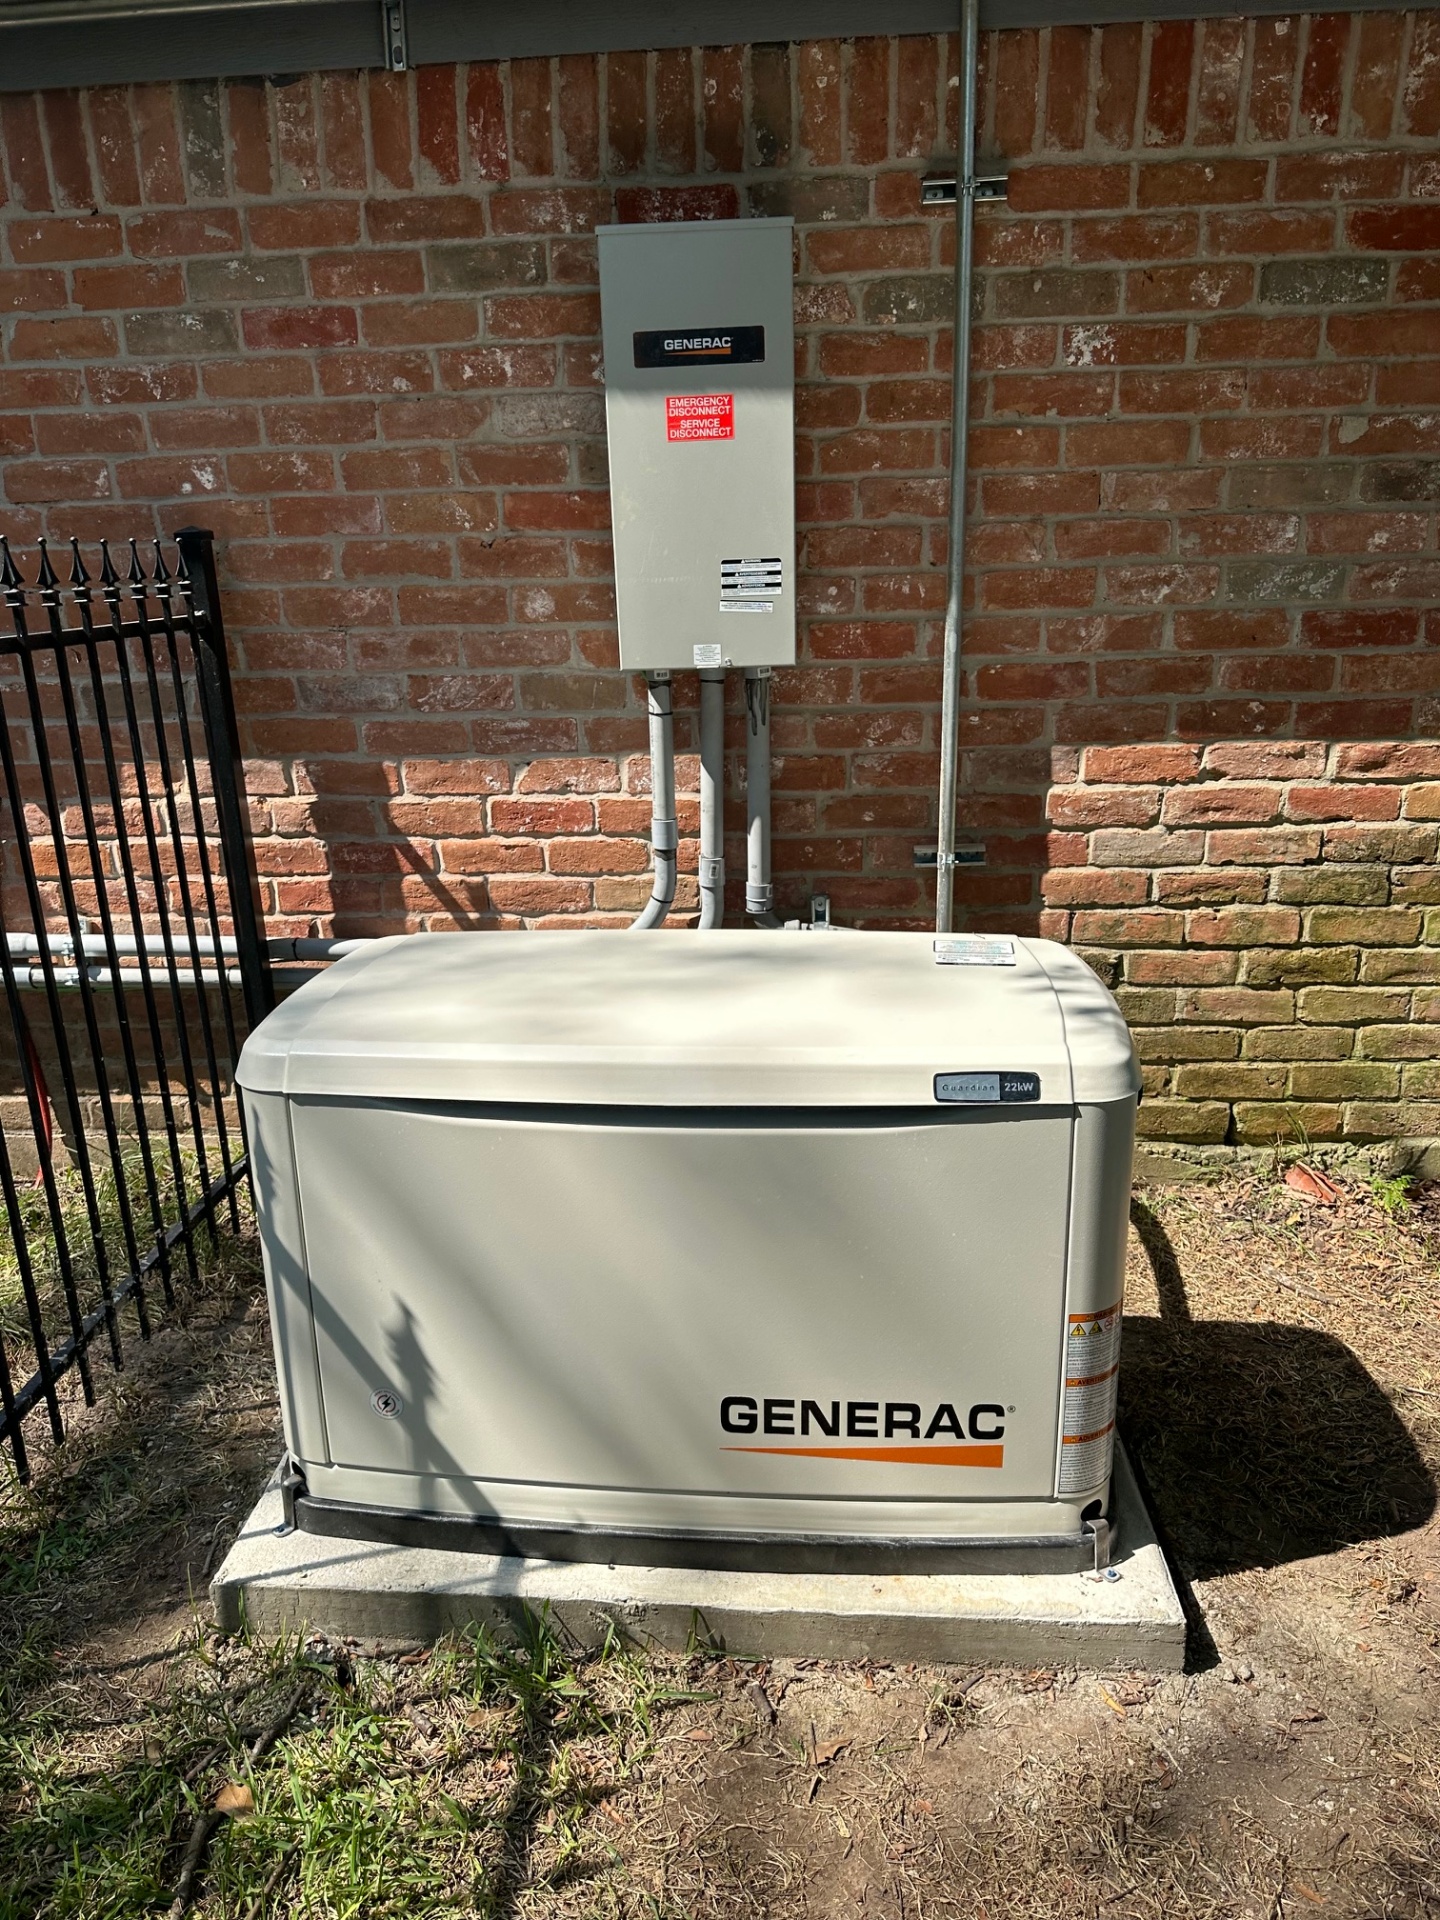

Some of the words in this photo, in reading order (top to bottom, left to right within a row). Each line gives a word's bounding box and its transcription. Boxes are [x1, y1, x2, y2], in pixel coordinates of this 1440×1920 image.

[664, 337, 731, 350] GENERAC
[669, 396, 730, 408] EMERGENCY
[669, 406, 731, 417] DISCONNECT
[680, 418, 720, 429] SERVICE
[670, 427, 731, 438] DISCONNECT
[942, 1084, 995, 1092] Guardian
[1004, 1082, 1034, 1092] 22kW
